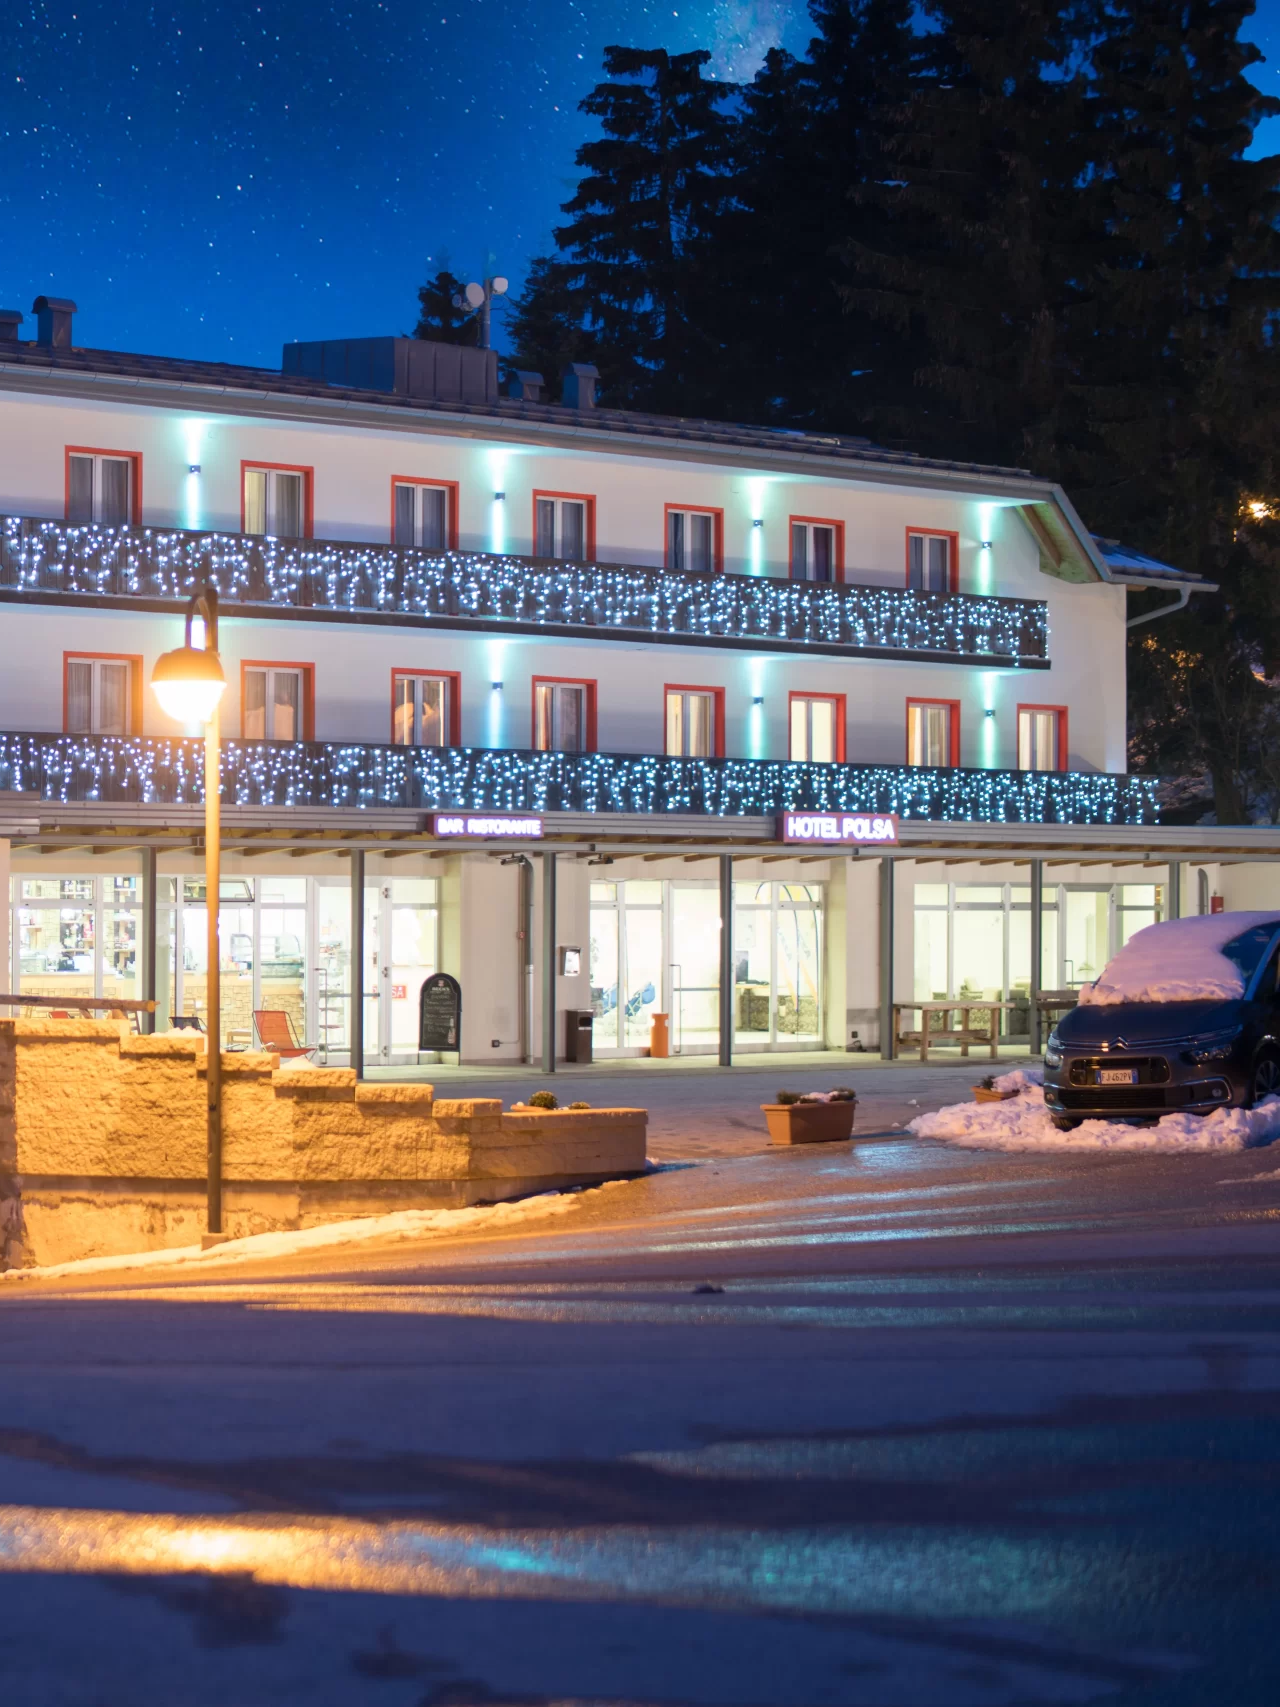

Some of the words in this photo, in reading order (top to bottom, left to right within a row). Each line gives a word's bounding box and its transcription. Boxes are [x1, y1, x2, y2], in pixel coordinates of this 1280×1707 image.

[437, 817, 464, 834] BAR
[787, 816, 841, 839] HOTEL
[842, 817, 895, 840] POLSA
